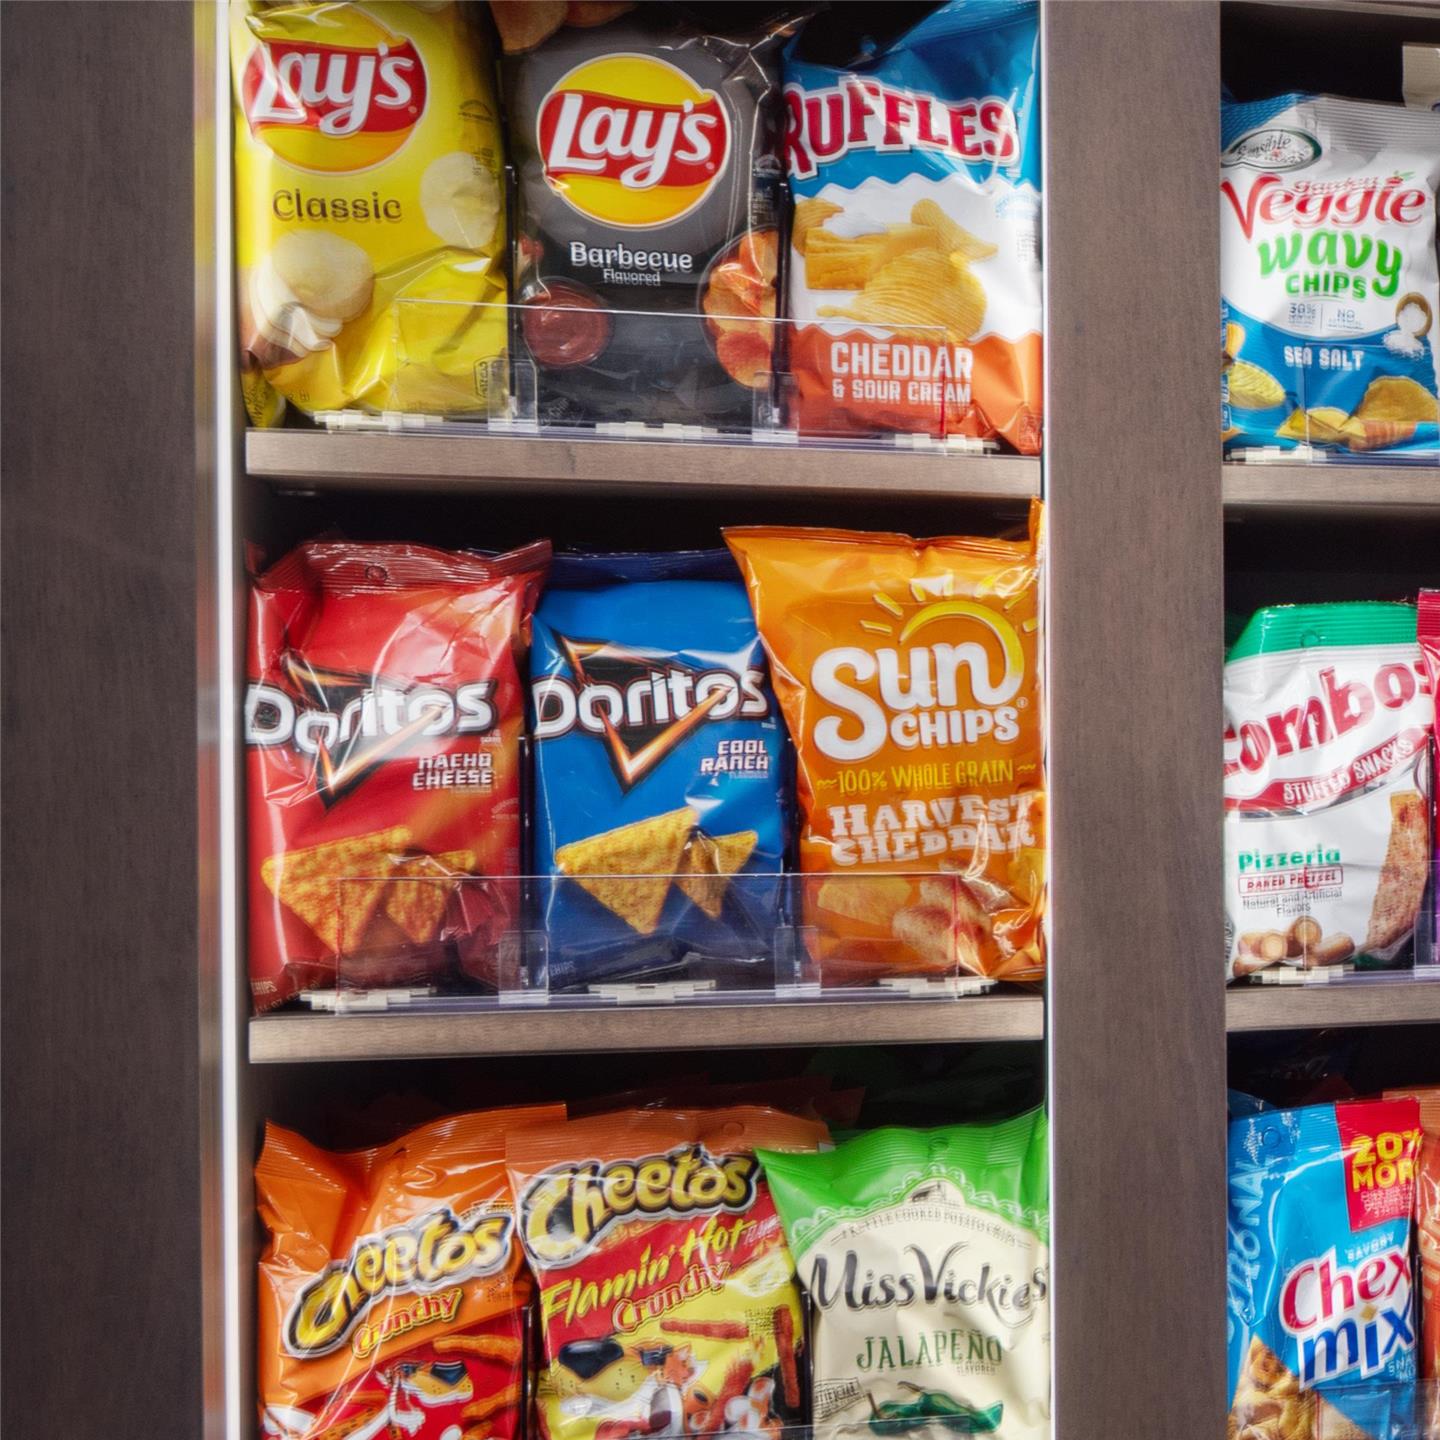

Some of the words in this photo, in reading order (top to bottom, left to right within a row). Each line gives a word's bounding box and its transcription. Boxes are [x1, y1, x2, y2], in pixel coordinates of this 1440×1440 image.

[250, 42, 418, 137] Lay's
[548, 93, 718, 190] Lay's
[784, 80, 1018, 176] RUFFLES
[272, 189, 402, 223] Classic
[1221, 172, 1426, 240] Veggie
[569, 241, 693, 272] Barbecue
[1257, 229, 1403, 298] wavy
[1285, 271, 1367, 300] CHIPS
[830, 341, 973, 380] CHEDDAR
[1284, 345, 1312, 367] SEA
[1318, 348, 1365, 370] SALT
[833, 381, 845, 400] &
[852, 380, 900, 402] SOUR
[907, 381, 971, 404] CREAM
[246, 681, 497, 754] Doritos
[533, 669, 767, 739] Doritos
[811, 636, 1025, 762] Sun
[717, 740, 768, 757] COOL
[890, 707, 1020, 749] CHIPS
[412, 770, 494, 792] CHEESE
[417, 752, 493, 772] NACHO
[701, 755, 769, 774] RANCH
[837, 768, 887, 794] 100%
[890, 764, 951, 792] WHOLE
[955, 760, 1013, 787] GRAIN
[1283, 767, 1350, 805] STUFFED
[1353, 738, 1414, 781] SNACKS
[828, 793, 1036, 839] HARVEST
[830, 822, 1035, 866] CHEDDAR
[1238, 845, 1341, 872] Pizzeria
[523, 1146, 760, 1266] Cheetos
[1347, 1232, 1394, 1261] SAVORY
[284, 1208, 518, 1358] Cheetos
[612, 1260, 731, 1335] Crunchy
[1281, 1251, 1412, 1331] Chex
[352, 1287, 462, 1359] Crunchy
[1303, 1301, 1416, 1382] mix
[856, 1328, 1003, 1373] JALAPEÑO
